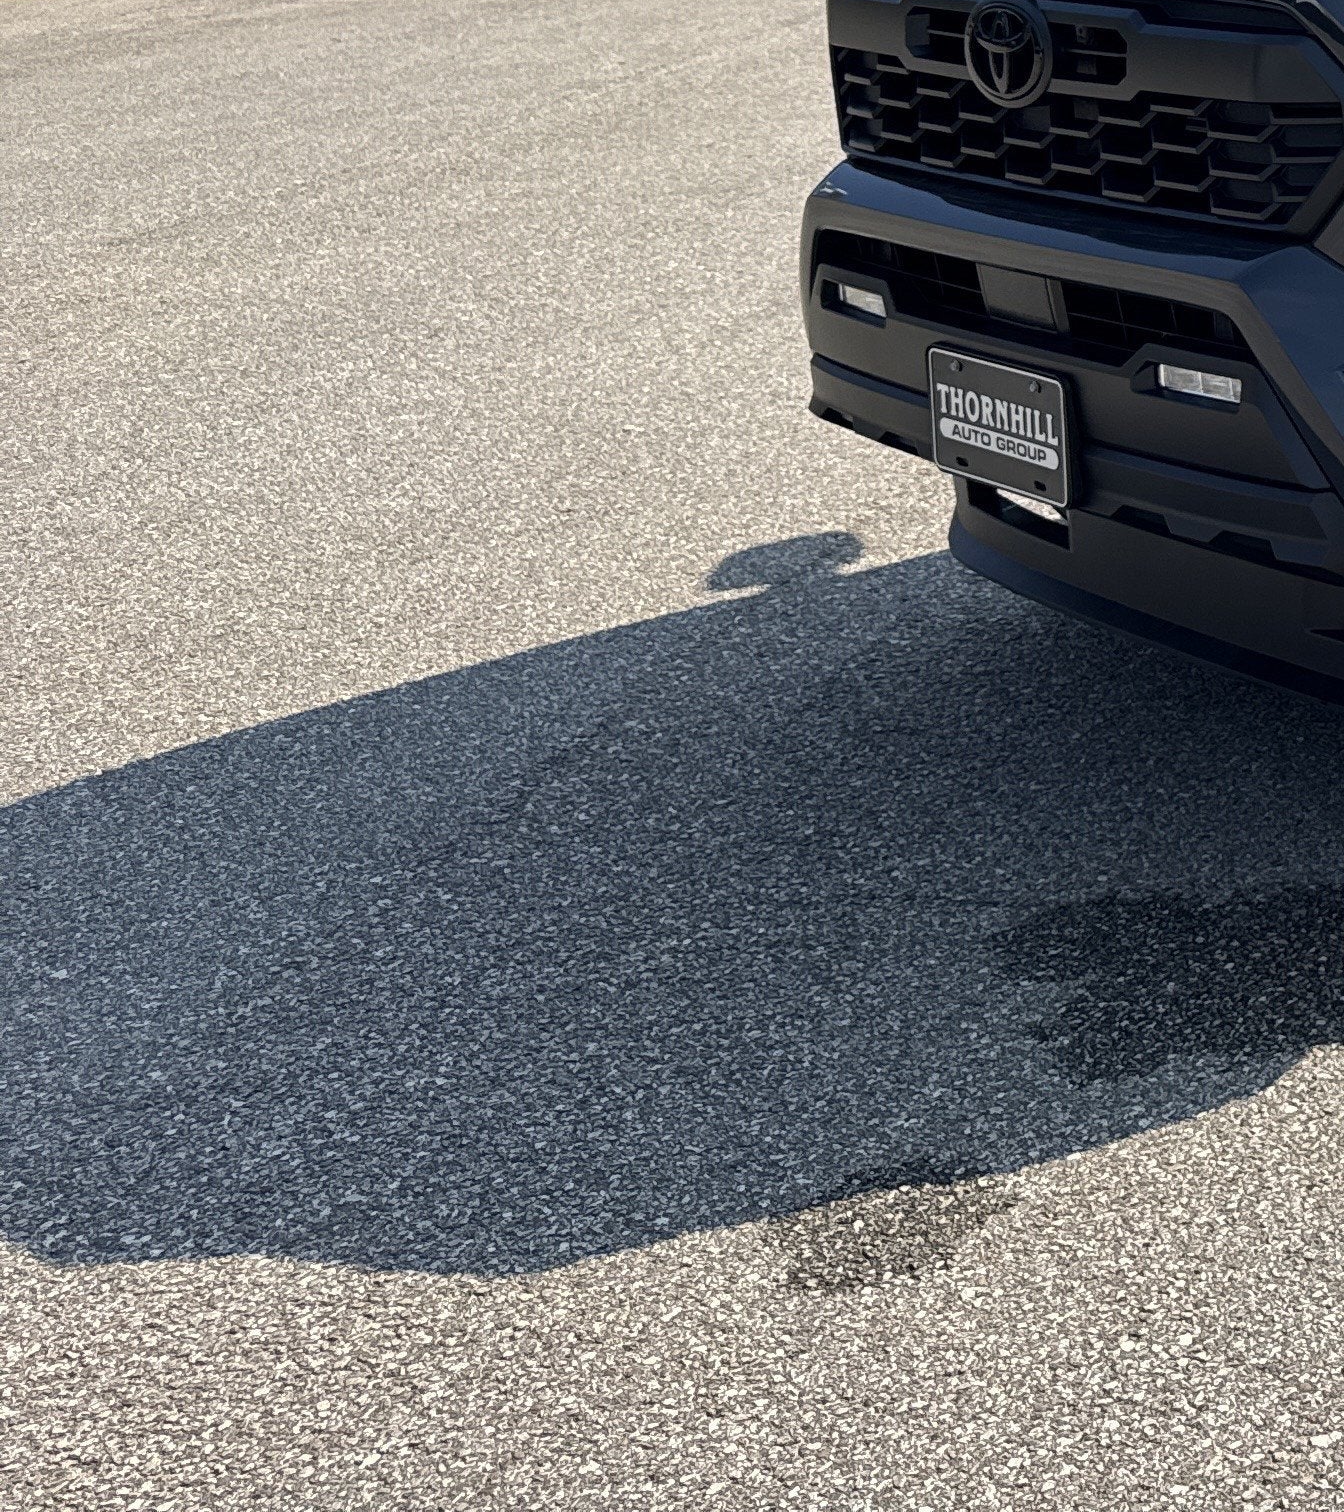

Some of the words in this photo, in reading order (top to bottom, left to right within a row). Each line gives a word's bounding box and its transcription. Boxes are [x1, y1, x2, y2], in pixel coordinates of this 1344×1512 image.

[936, 382, 1059, 447] THORNHILL
[952, 423, 992, 447] AUTO
[996, 436, 1047, 463] GROUP
